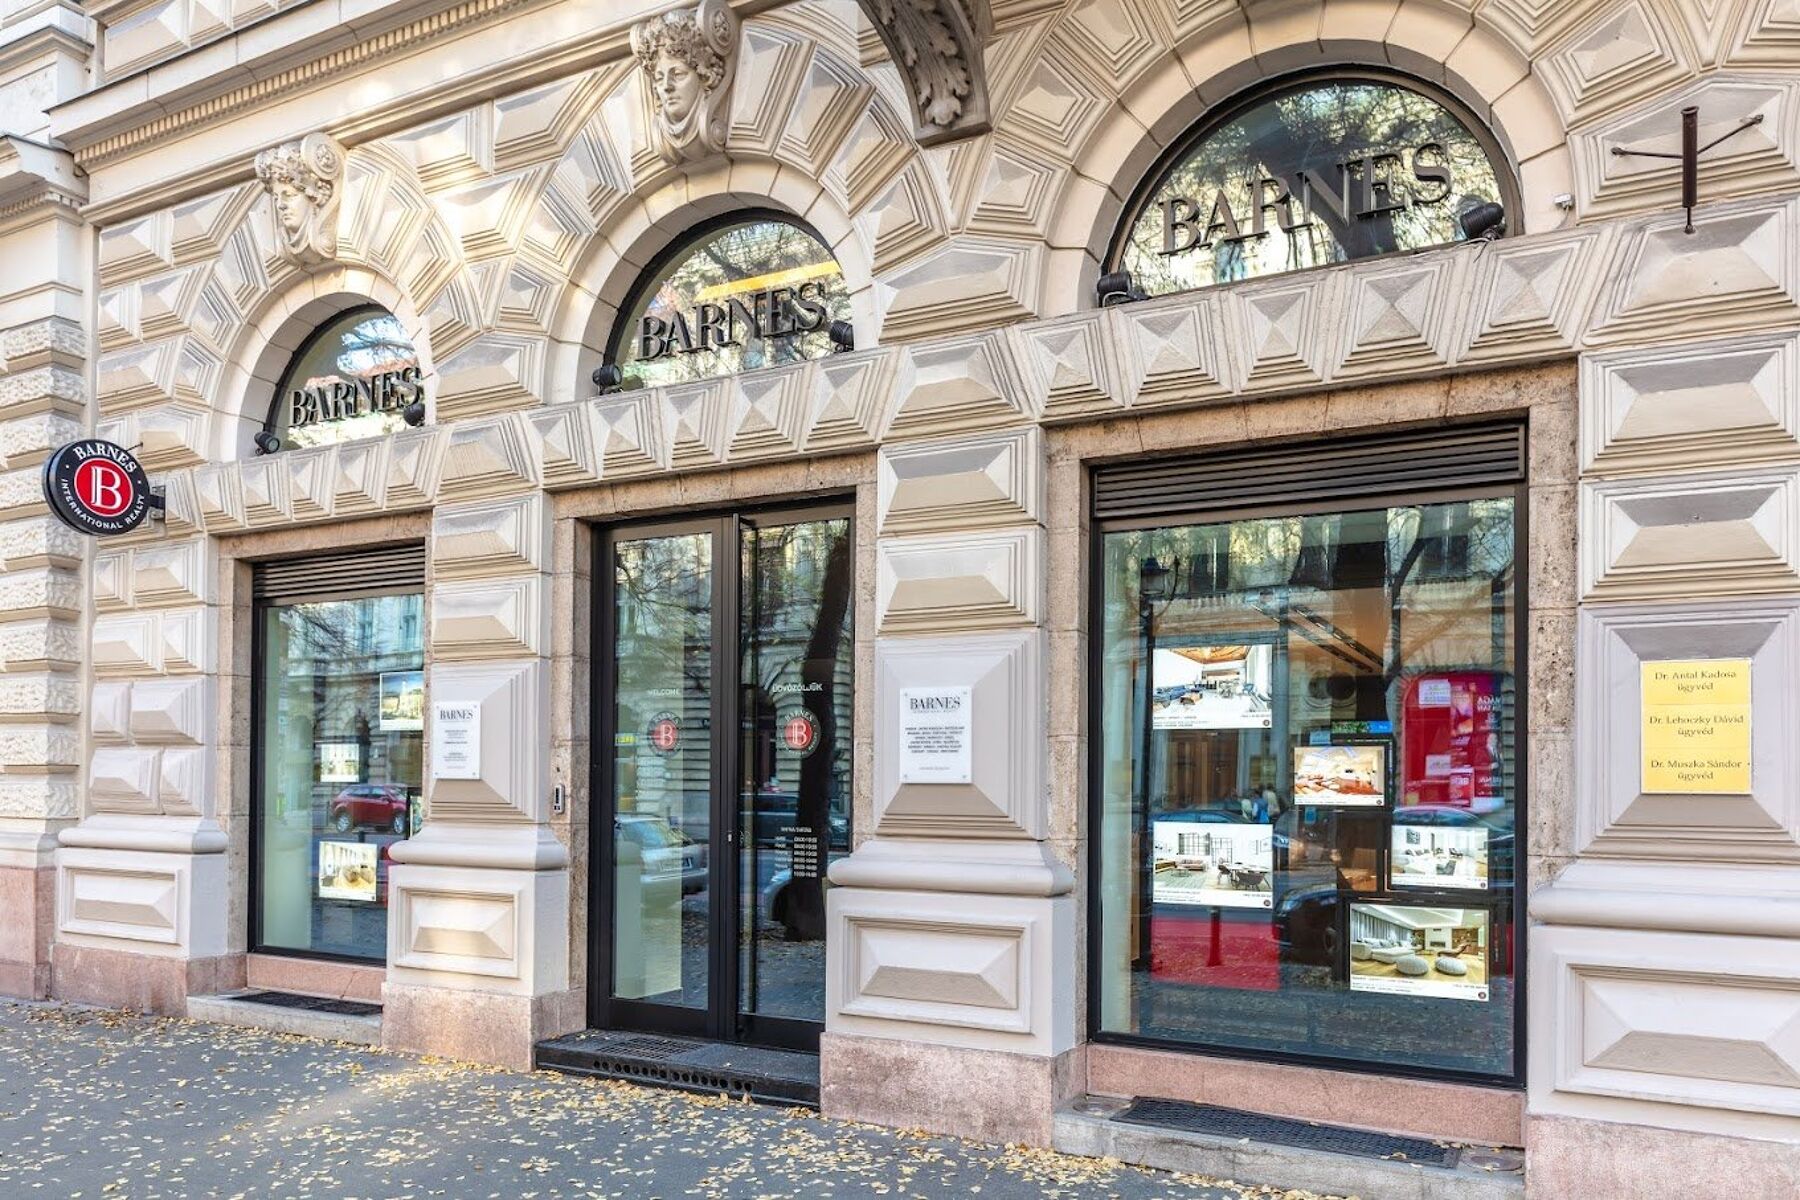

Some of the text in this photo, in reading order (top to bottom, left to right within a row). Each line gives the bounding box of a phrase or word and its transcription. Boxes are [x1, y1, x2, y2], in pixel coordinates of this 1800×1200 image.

[1157, 143, 1452, 256] BARNES
[635, 282, 827, 362] BARNES
[288, 367, 423, 428] BARNES
[73, 442, 137, 473] BARNES
[91, 466, 122, 509] B
[61, 478, 145, 529] INTERNATIONAL REALTY
[1672, 671, 1698, 680] Antal
[1700, 670, 1737, 679] Kadosa
[1677, 683, 1714, 692] ügyvéd
[909, 697, 961, 710] BARNES
[440, 709, 474, 720] BARNES
[792, 722, 807, 746] B
[1677, 727, 1714, 737] ügyvéd
[1651, 760, 1742, 768] Dr. Muszka Sándor
[1677, 772, 1714, 781] ügyvéd
